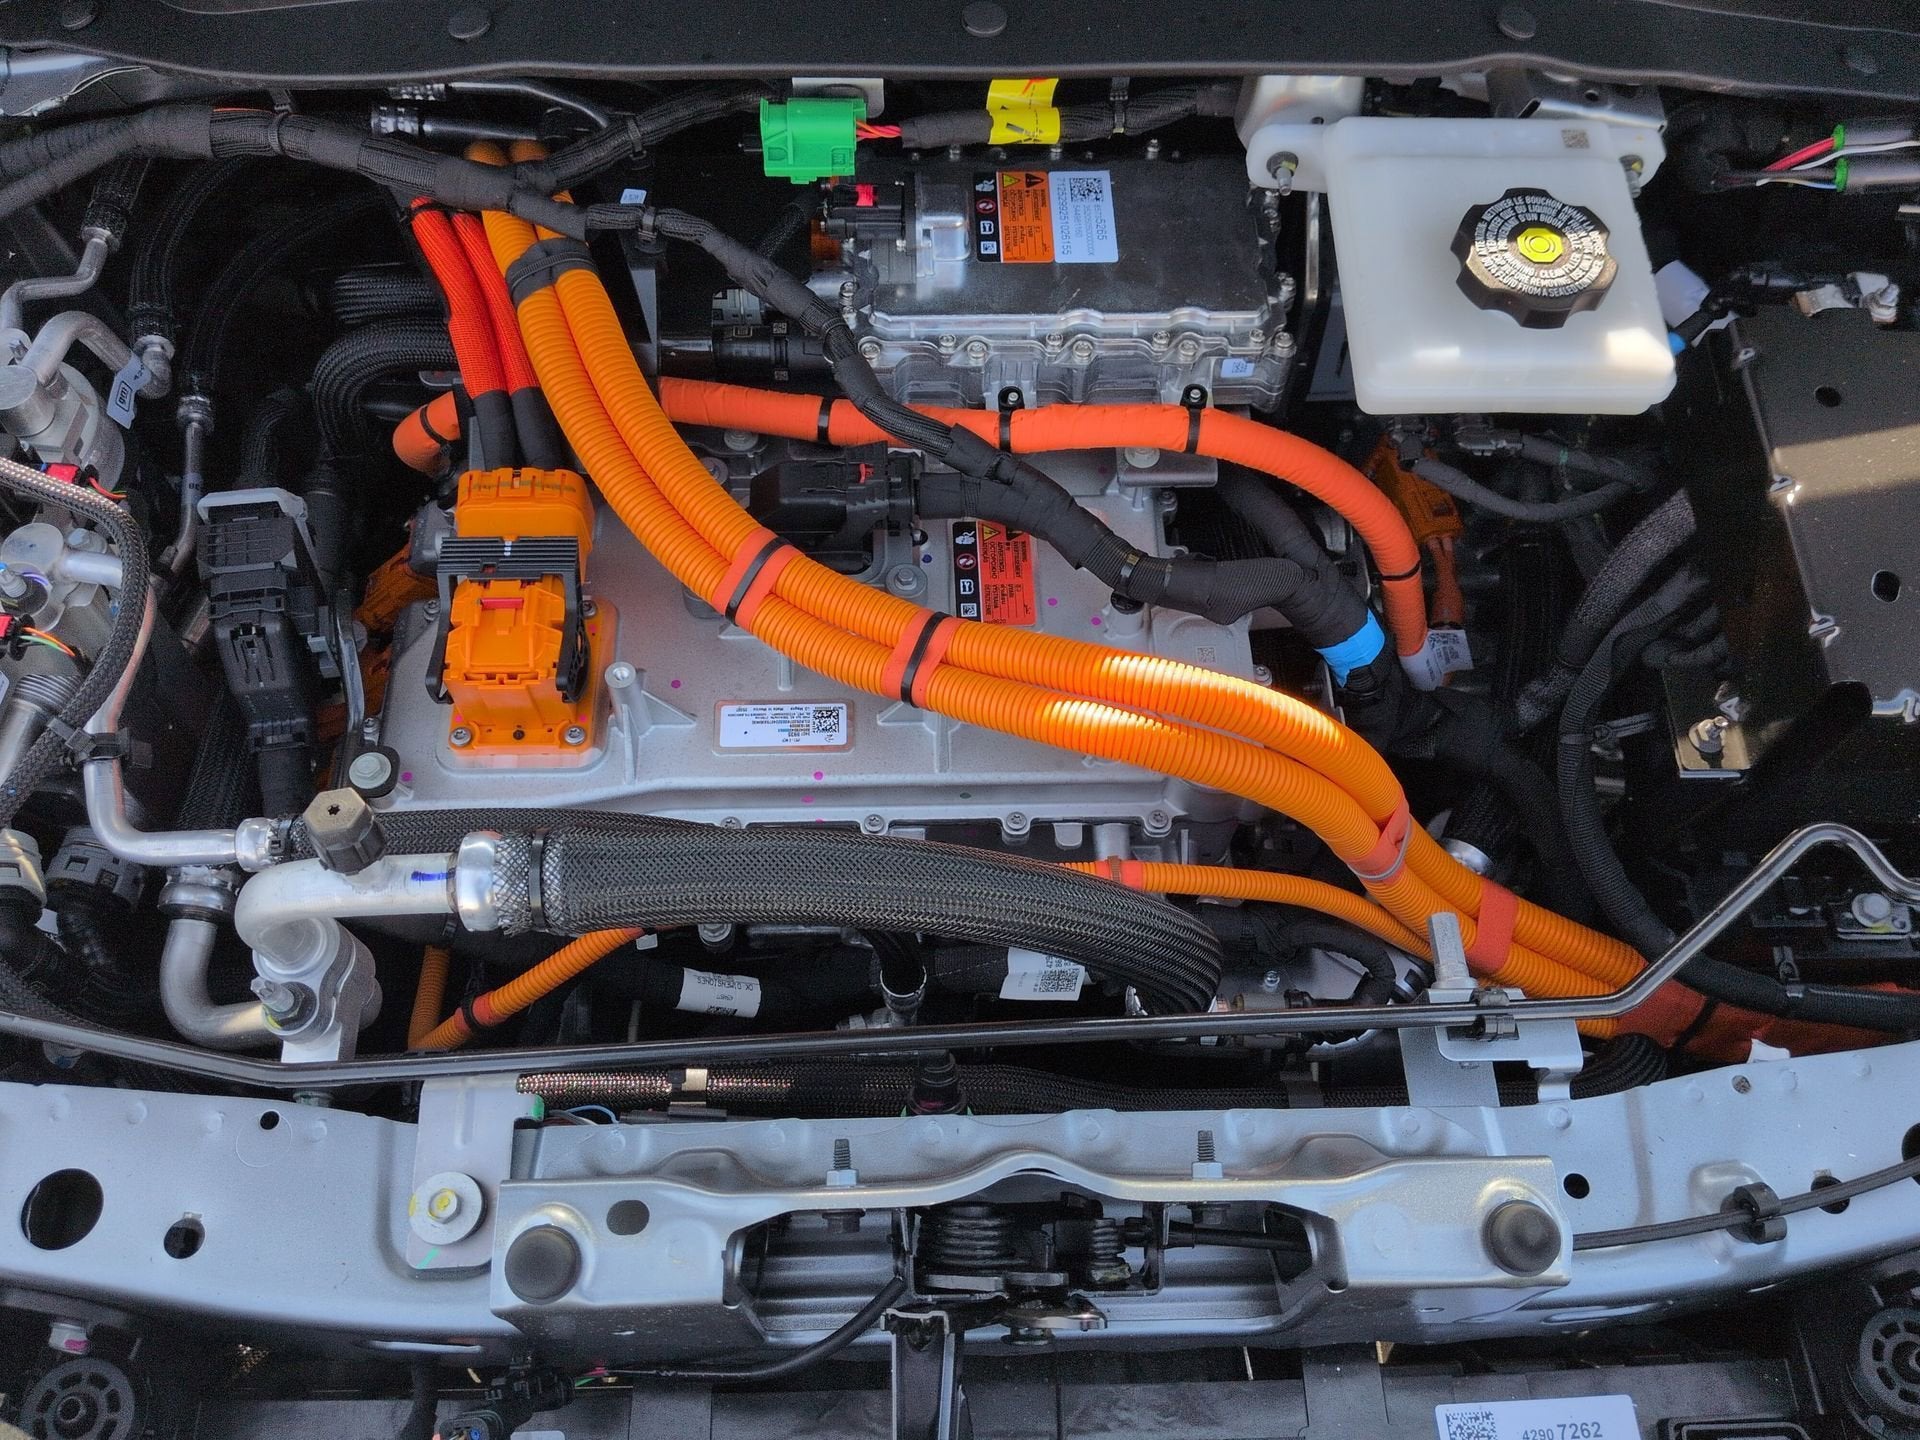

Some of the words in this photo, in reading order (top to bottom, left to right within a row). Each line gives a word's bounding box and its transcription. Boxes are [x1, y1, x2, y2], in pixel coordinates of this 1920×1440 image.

[1512, 196, 1525, 207] LE
[1525, 195, 1563, 211] BOUCHON
[1561, 205, 1588, 222] AVANT
[1582, 220, 1596, 233] LA
[1540, 213, 1565, 230] BIDON
[1517, 283, 1543, 297] FROM
[1548, 284, 1579, 298] SEALED
[1523, 1429, 1554, 1440] 4290
[1556, 1421, 1603, 1440] 7262
